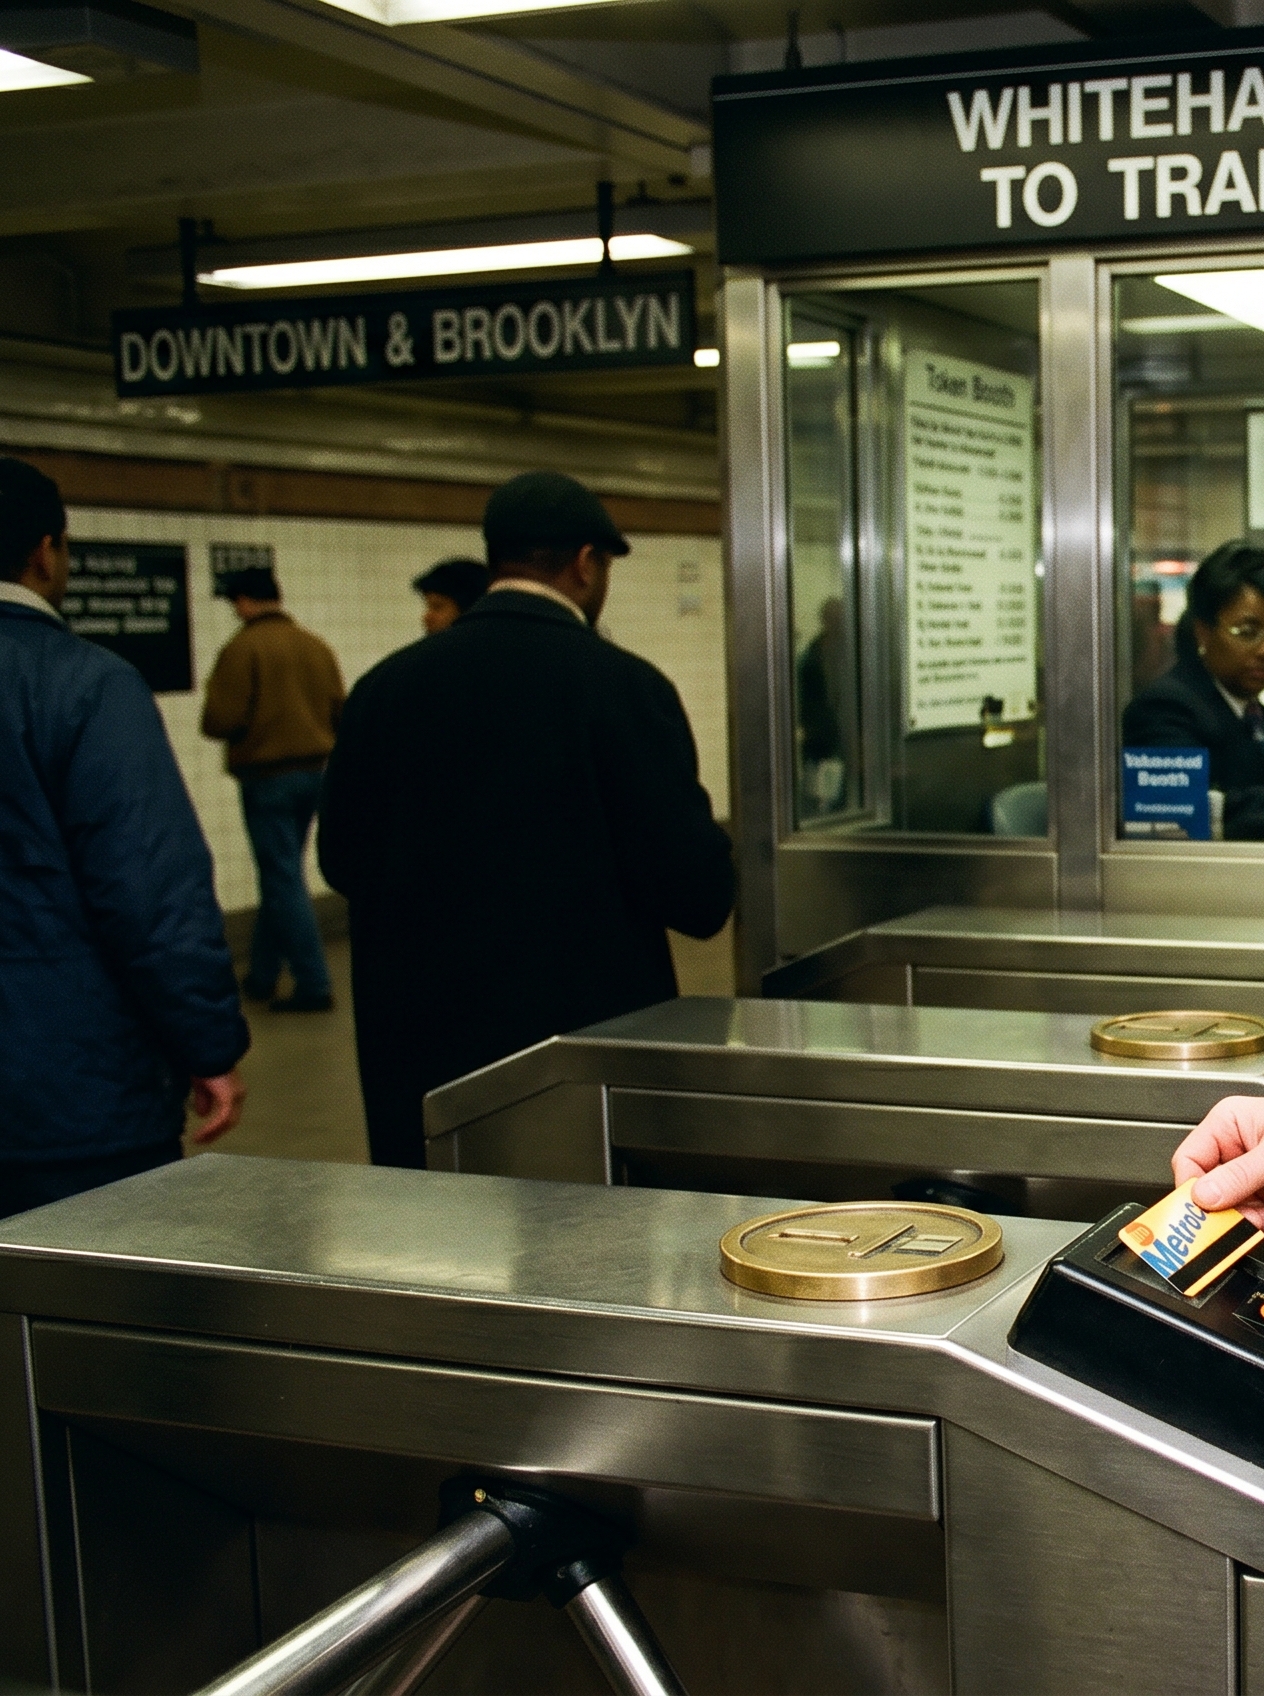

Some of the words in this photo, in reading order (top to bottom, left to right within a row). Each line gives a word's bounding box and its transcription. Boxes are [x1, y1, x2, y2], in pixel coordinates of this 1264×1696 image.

[980, 161, 1079, 229] TO
[120, 314, 369, 384] DOWNTOWN
[384, 312, 416, 368] &
[431, 293, 681, 365] BROOKLYN
